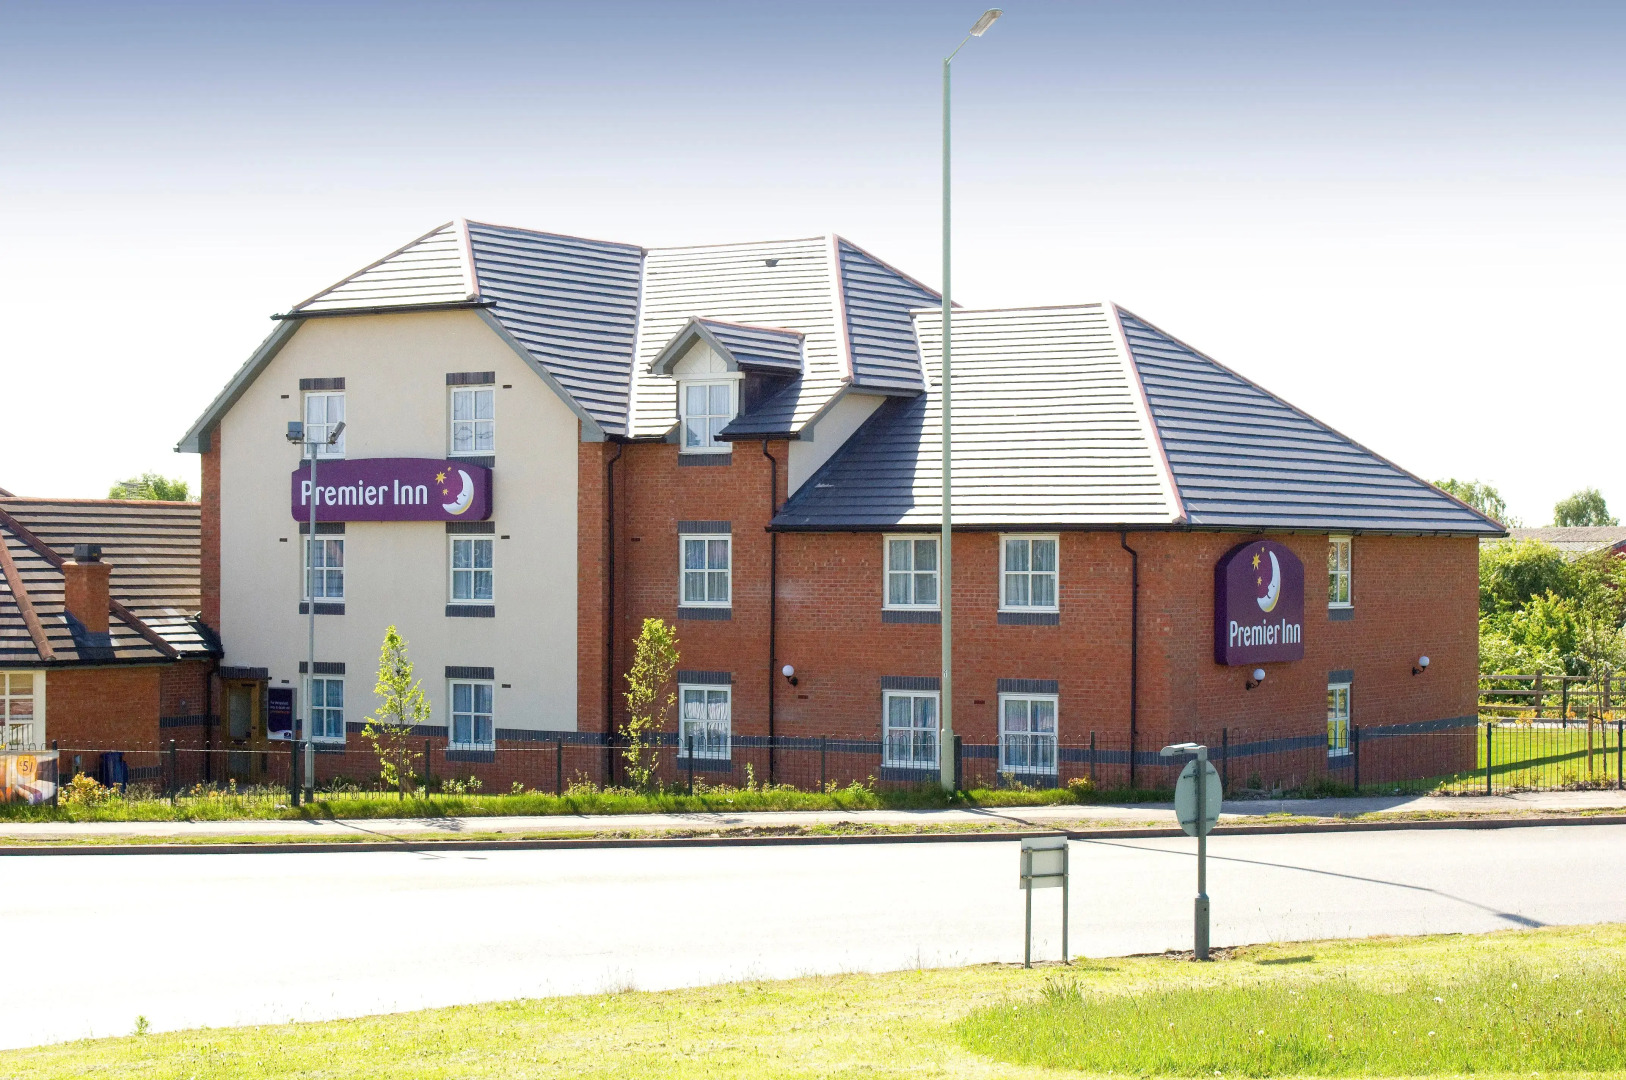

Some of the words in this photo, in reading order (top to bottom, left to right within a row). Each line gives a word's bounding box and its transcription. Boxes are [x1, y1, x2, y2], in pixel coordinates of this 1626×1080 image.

[301, 480, 388, 506] Premier
[393, 480, 428, 505] Inn
[1229, 619, 1280, 647] Premier
[1282, 618, 1301, 644] Inn
